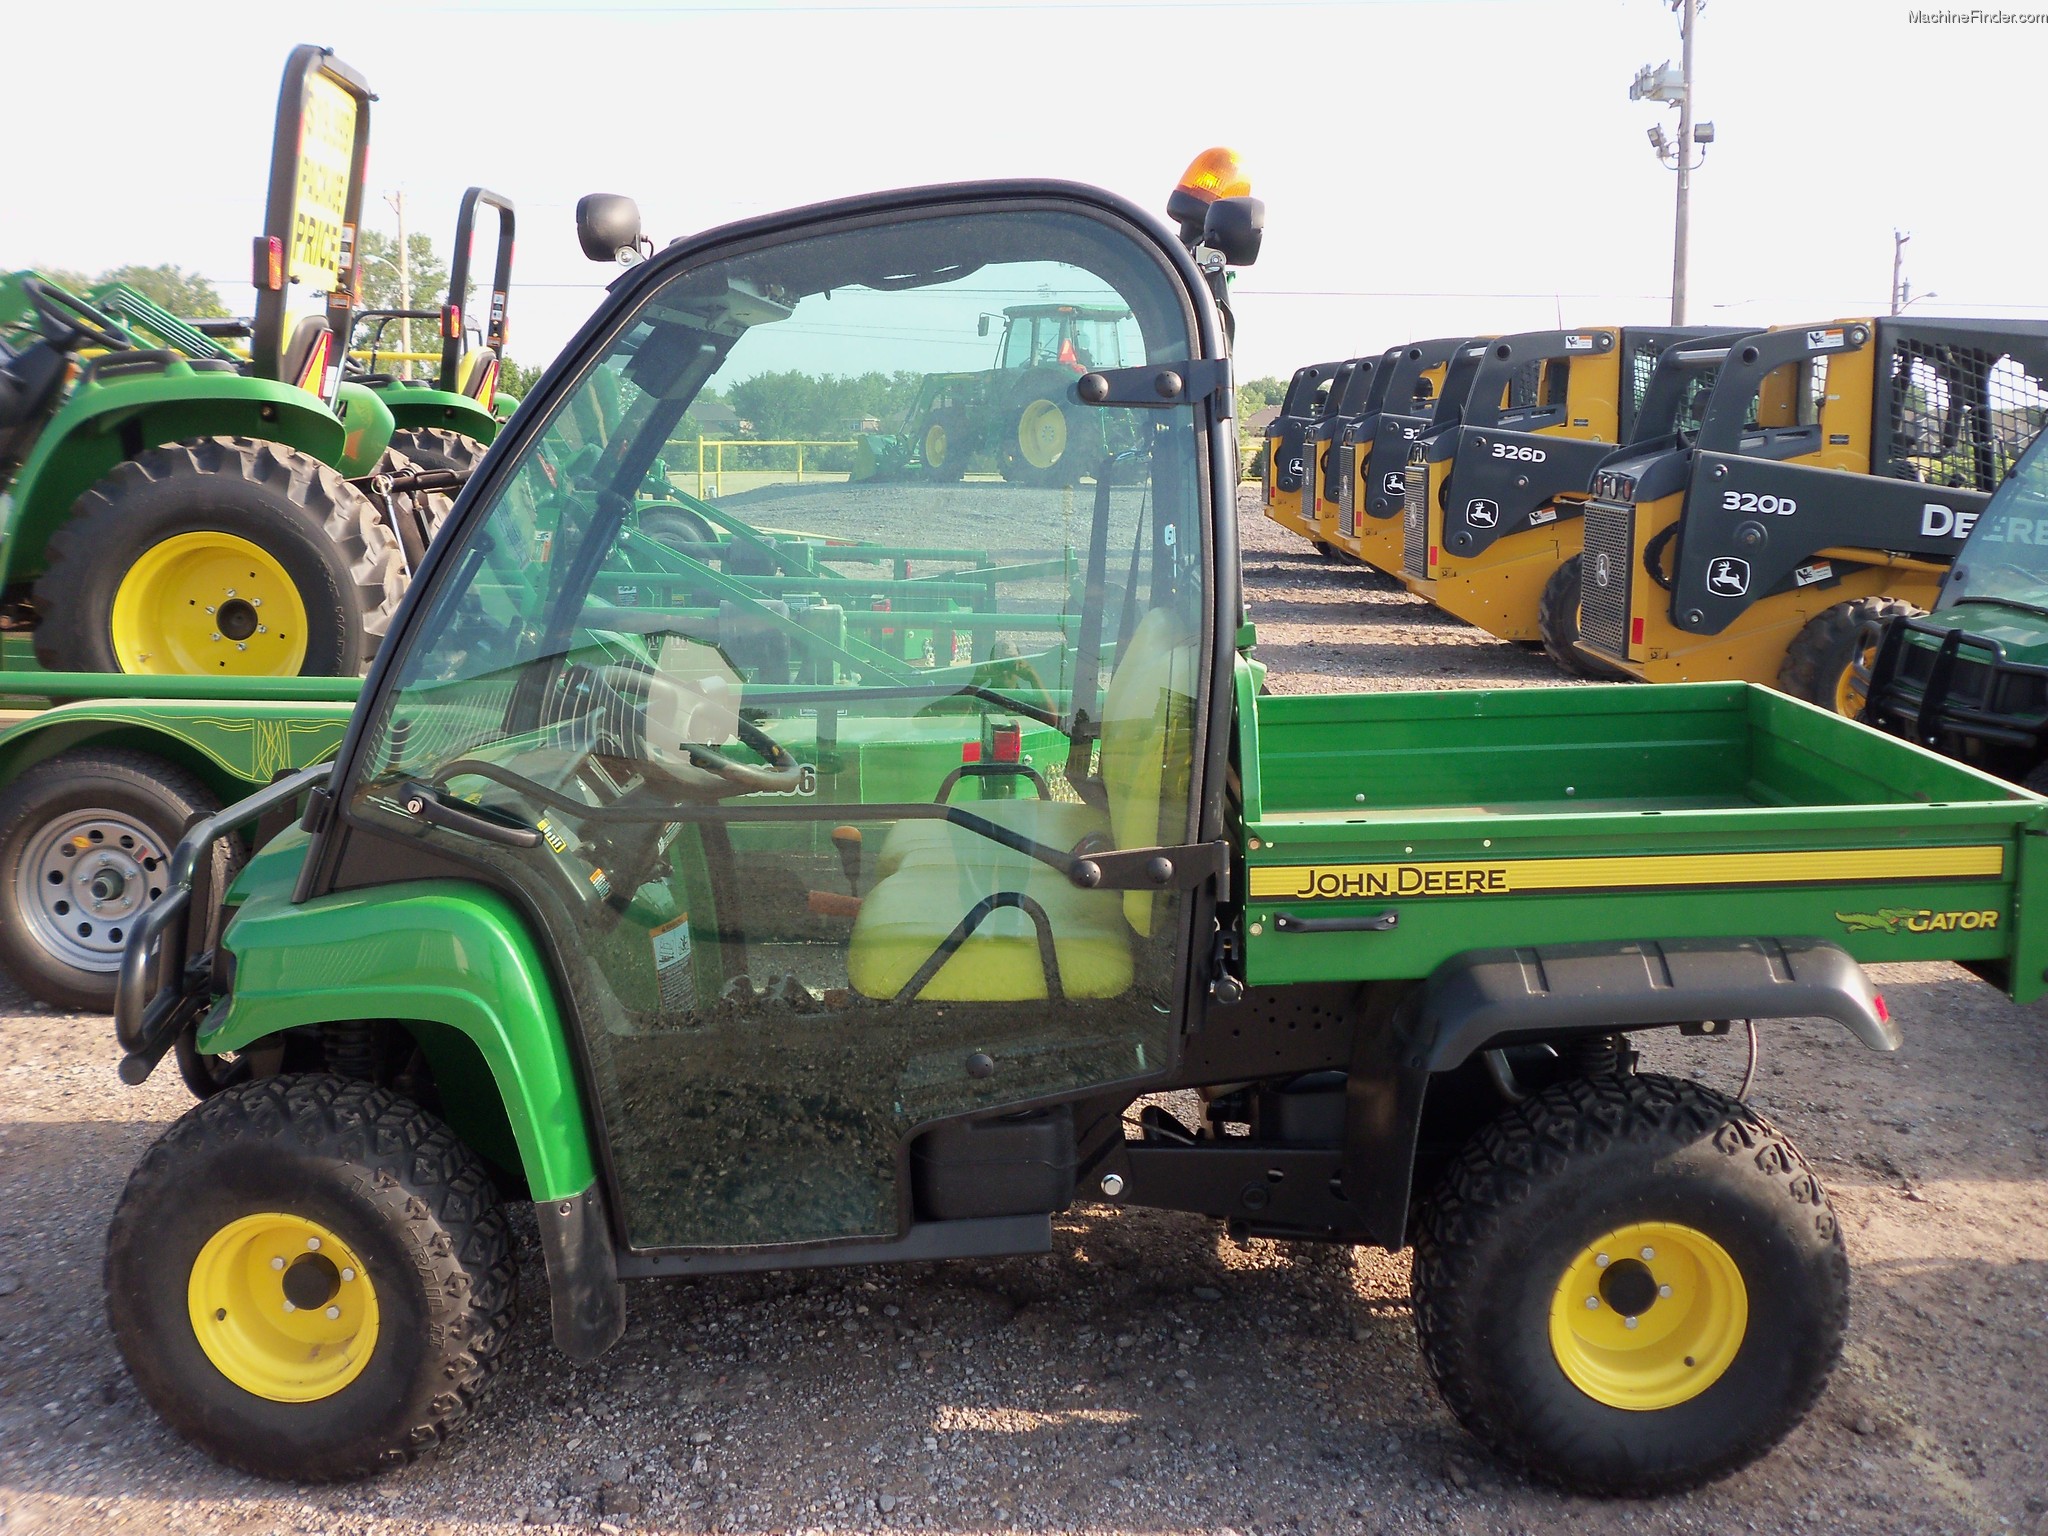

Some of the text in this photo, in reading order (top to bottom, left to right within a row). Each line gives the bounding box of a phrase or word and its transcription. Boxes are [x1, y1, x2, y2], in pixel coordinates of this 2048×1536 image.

[293, 212, 338, 271] PRICE
[1492, 443, 1547, 463] 326D
[1722, 491, 1797, 516] 320D
[1297, 866, 1508, 896] JOHN DEERE
[1908, 910, 1999, 932] GATOR
